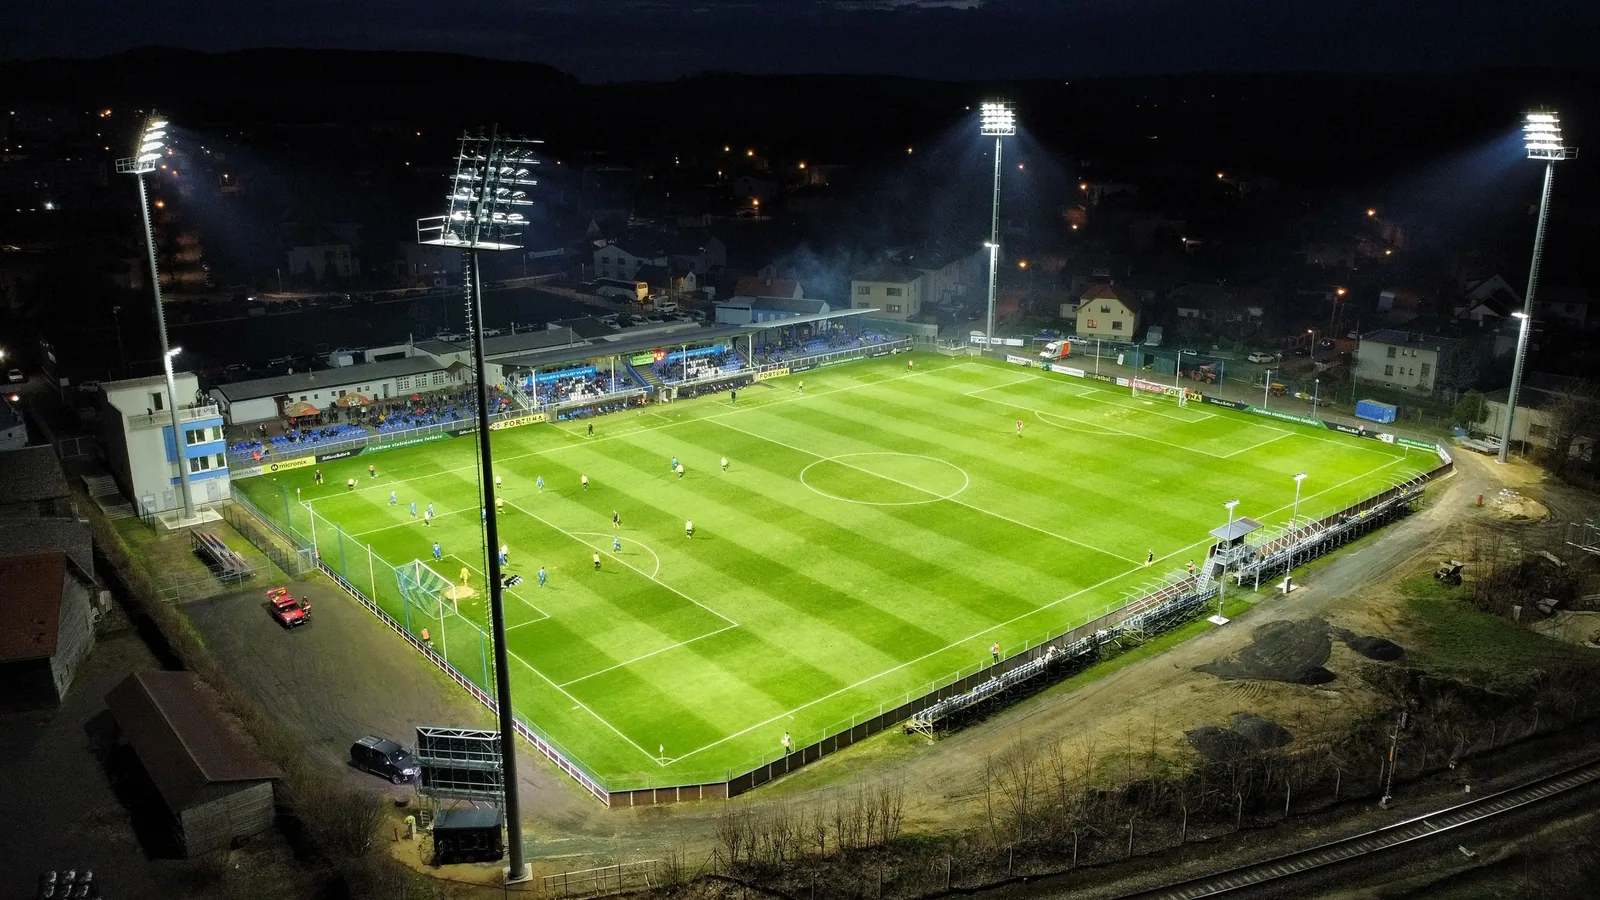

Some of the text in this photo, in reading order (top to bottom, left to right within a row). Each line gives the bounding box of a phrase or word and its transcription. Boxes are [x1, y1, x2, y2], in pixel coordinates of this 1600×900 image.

[759, 369, 789, 379] FORTUNA
[504, 415, 543, 428] FORTUNA
[279, 459, 307, 469] micronix
